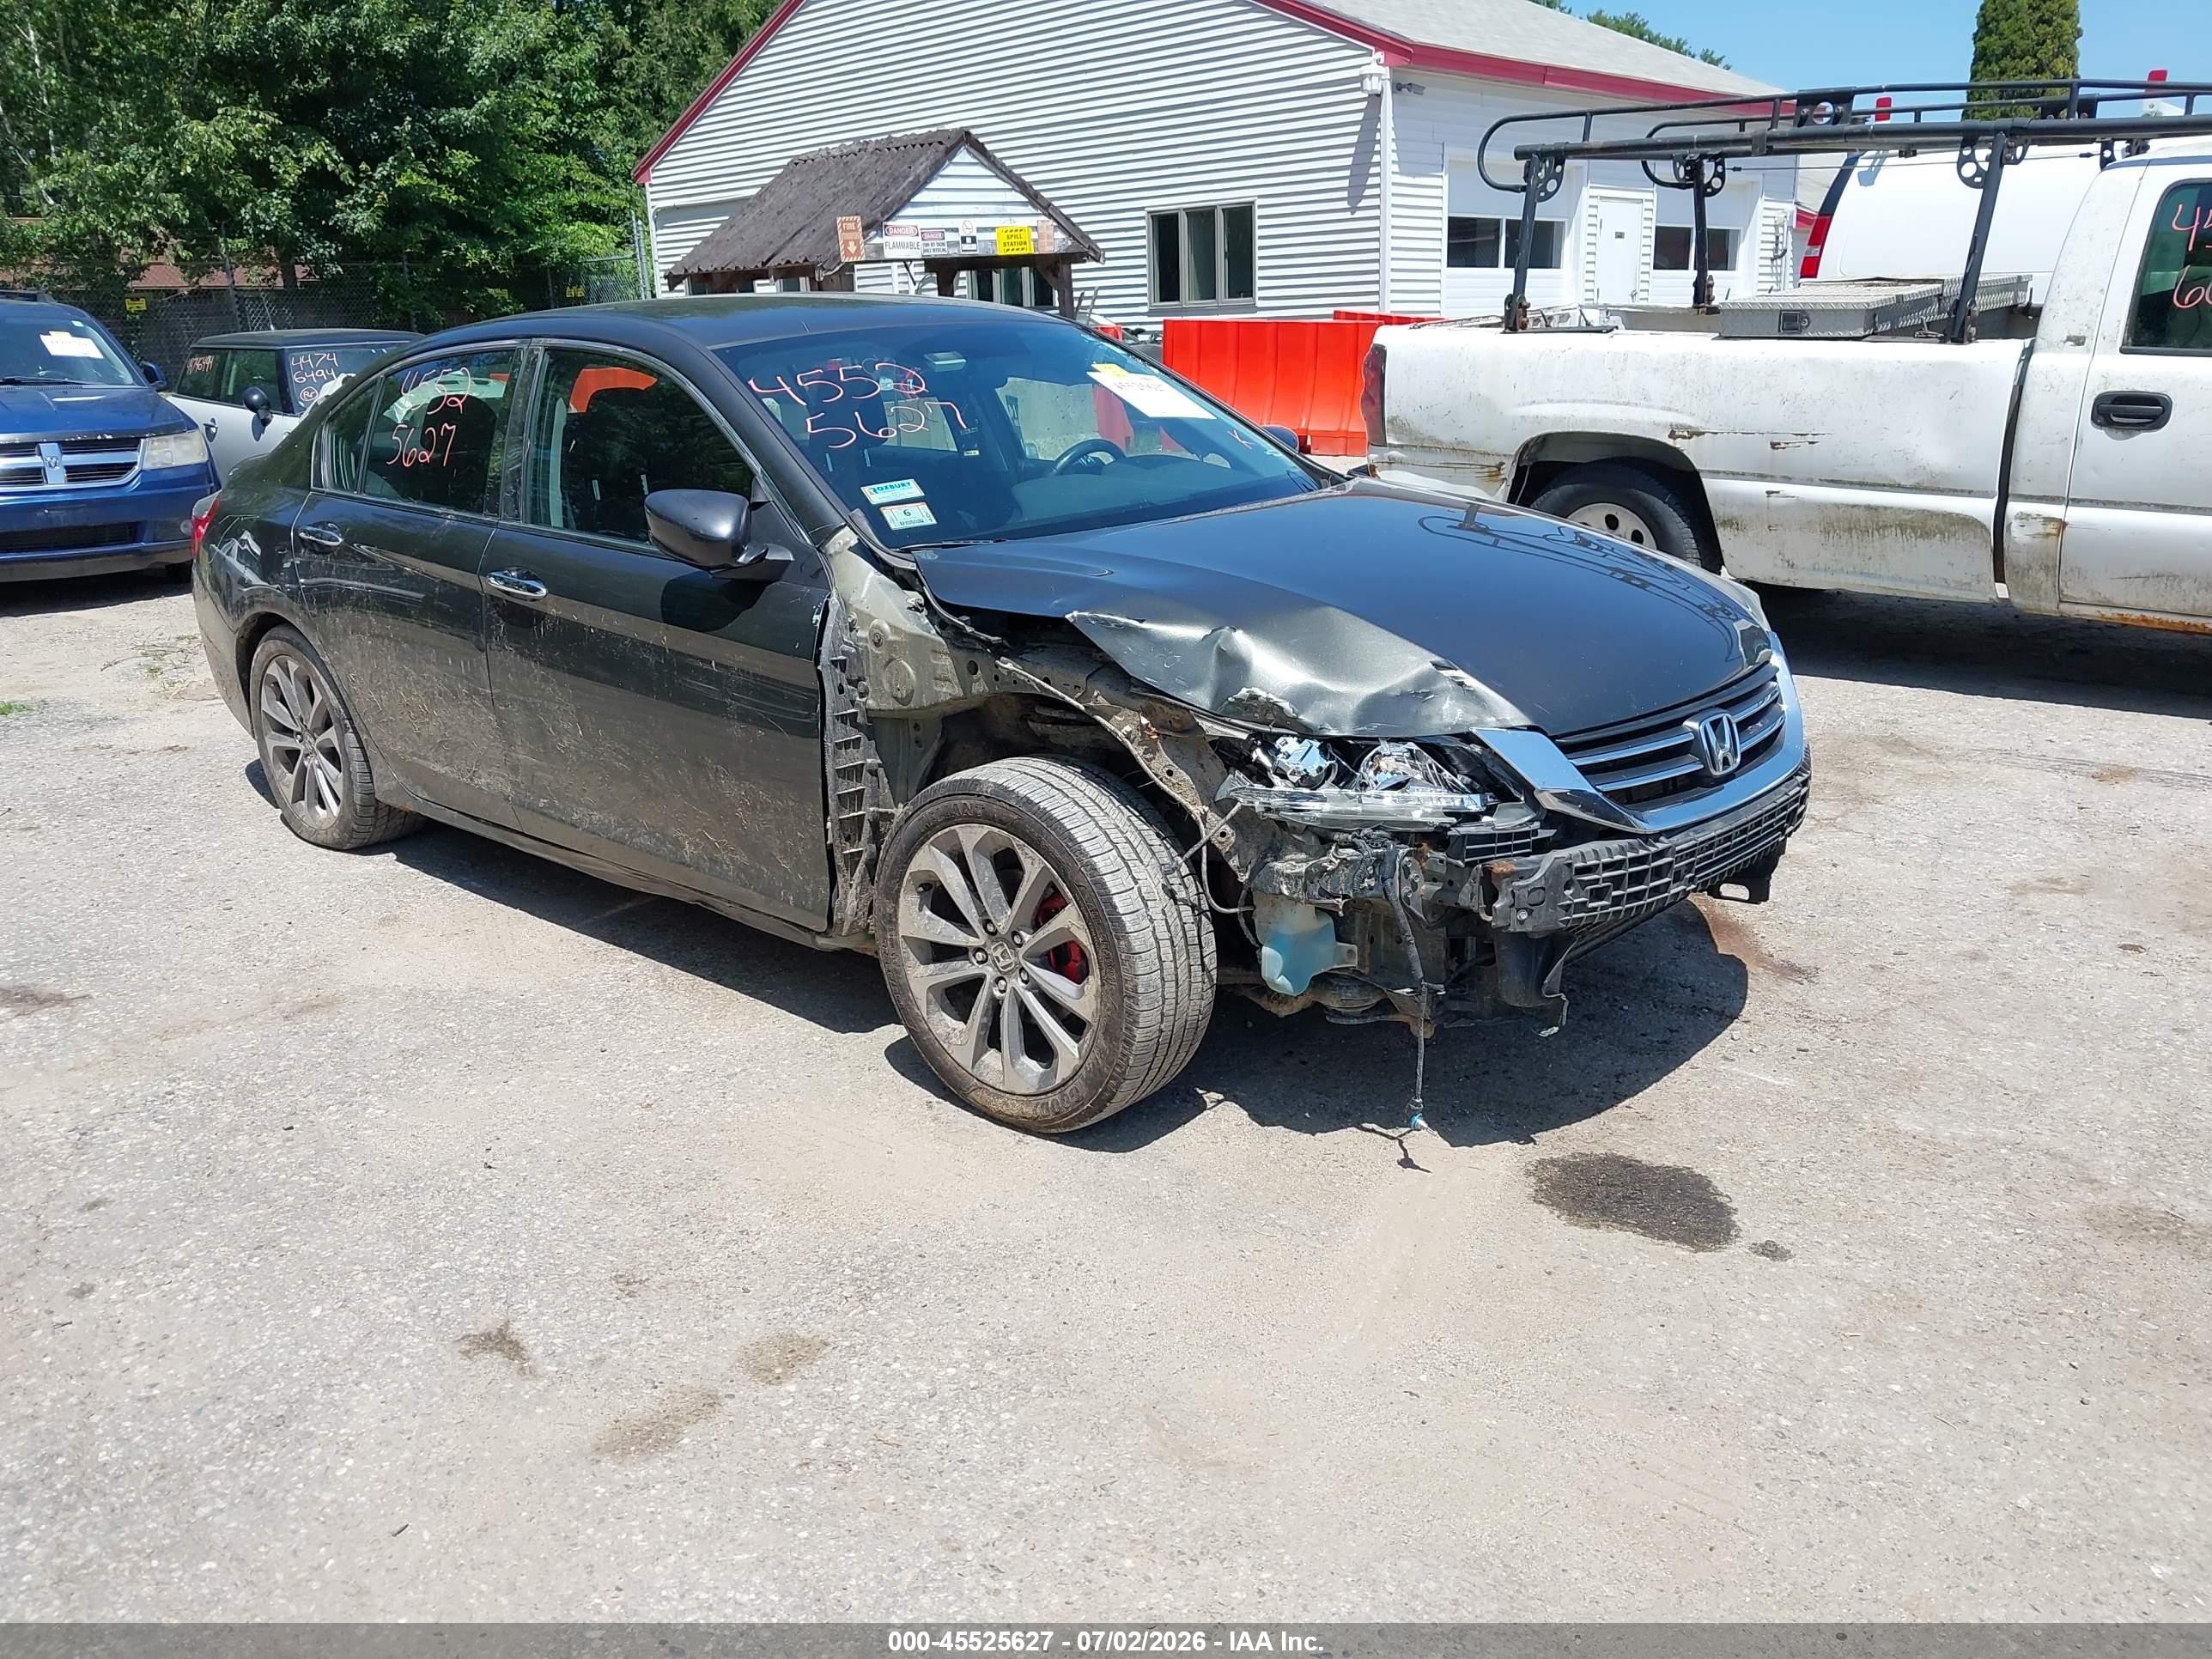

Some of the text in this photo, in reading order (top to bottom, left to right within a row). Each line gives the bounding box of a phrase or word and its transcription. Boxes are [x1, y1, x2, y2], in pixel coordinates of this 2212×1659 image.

[842, 222, 857, 231] FIRE
[889, 226, 915, 234] DANGER
[884, 240, 921, 251] FLAMMABLE
[292, 352, 338, 370] 4474
[294, 368, 337, 383] 6494
[401, 367, 471, 415] 4552
[747, 362, 929, 406] 4552
[805, 401, 968, 448] 5627
[386, 422, 457, 467] 5627
[869, 482, 911, 495] ROXBURY
